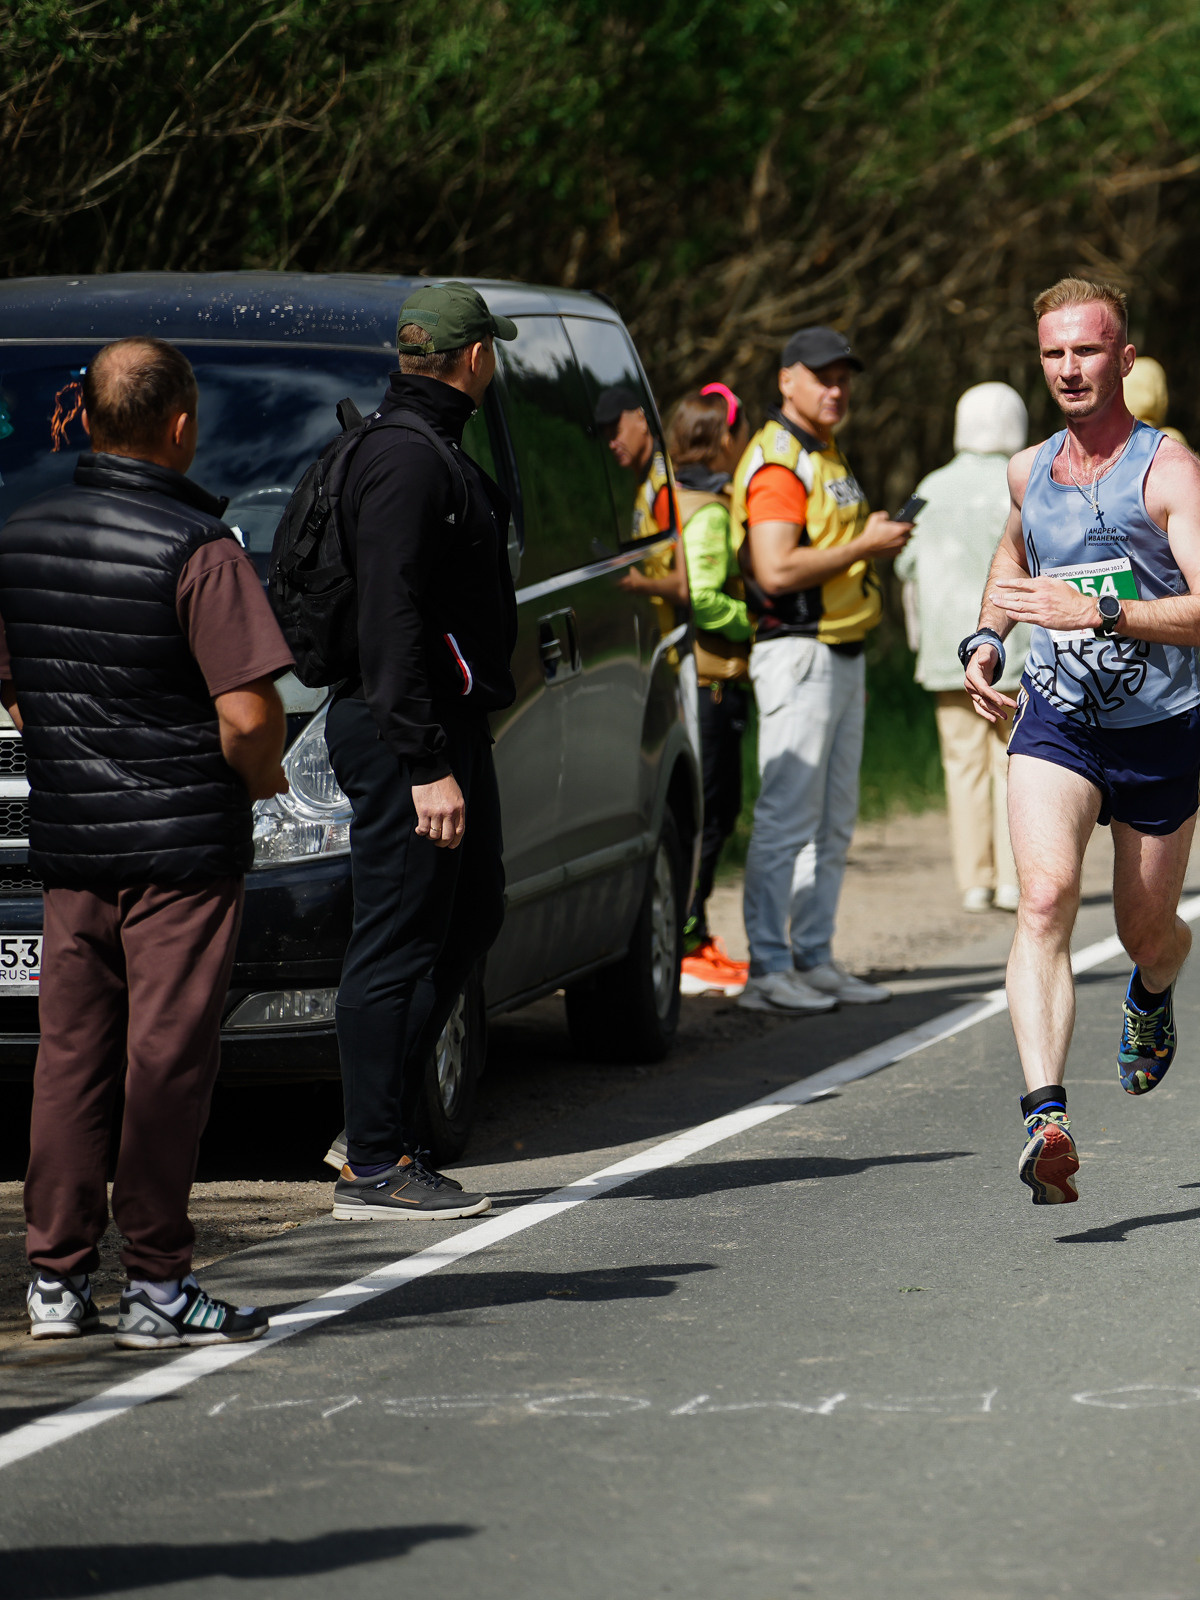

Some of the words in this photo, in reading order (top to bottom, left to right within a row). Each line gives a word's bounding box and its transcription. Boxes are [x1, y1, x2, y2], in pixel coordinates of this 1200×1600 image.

[1088, 526, 1117, 534] АНДРЕЙ
[0, 939, 39, 968] 53
[0, 969, 27, 980] RUS
